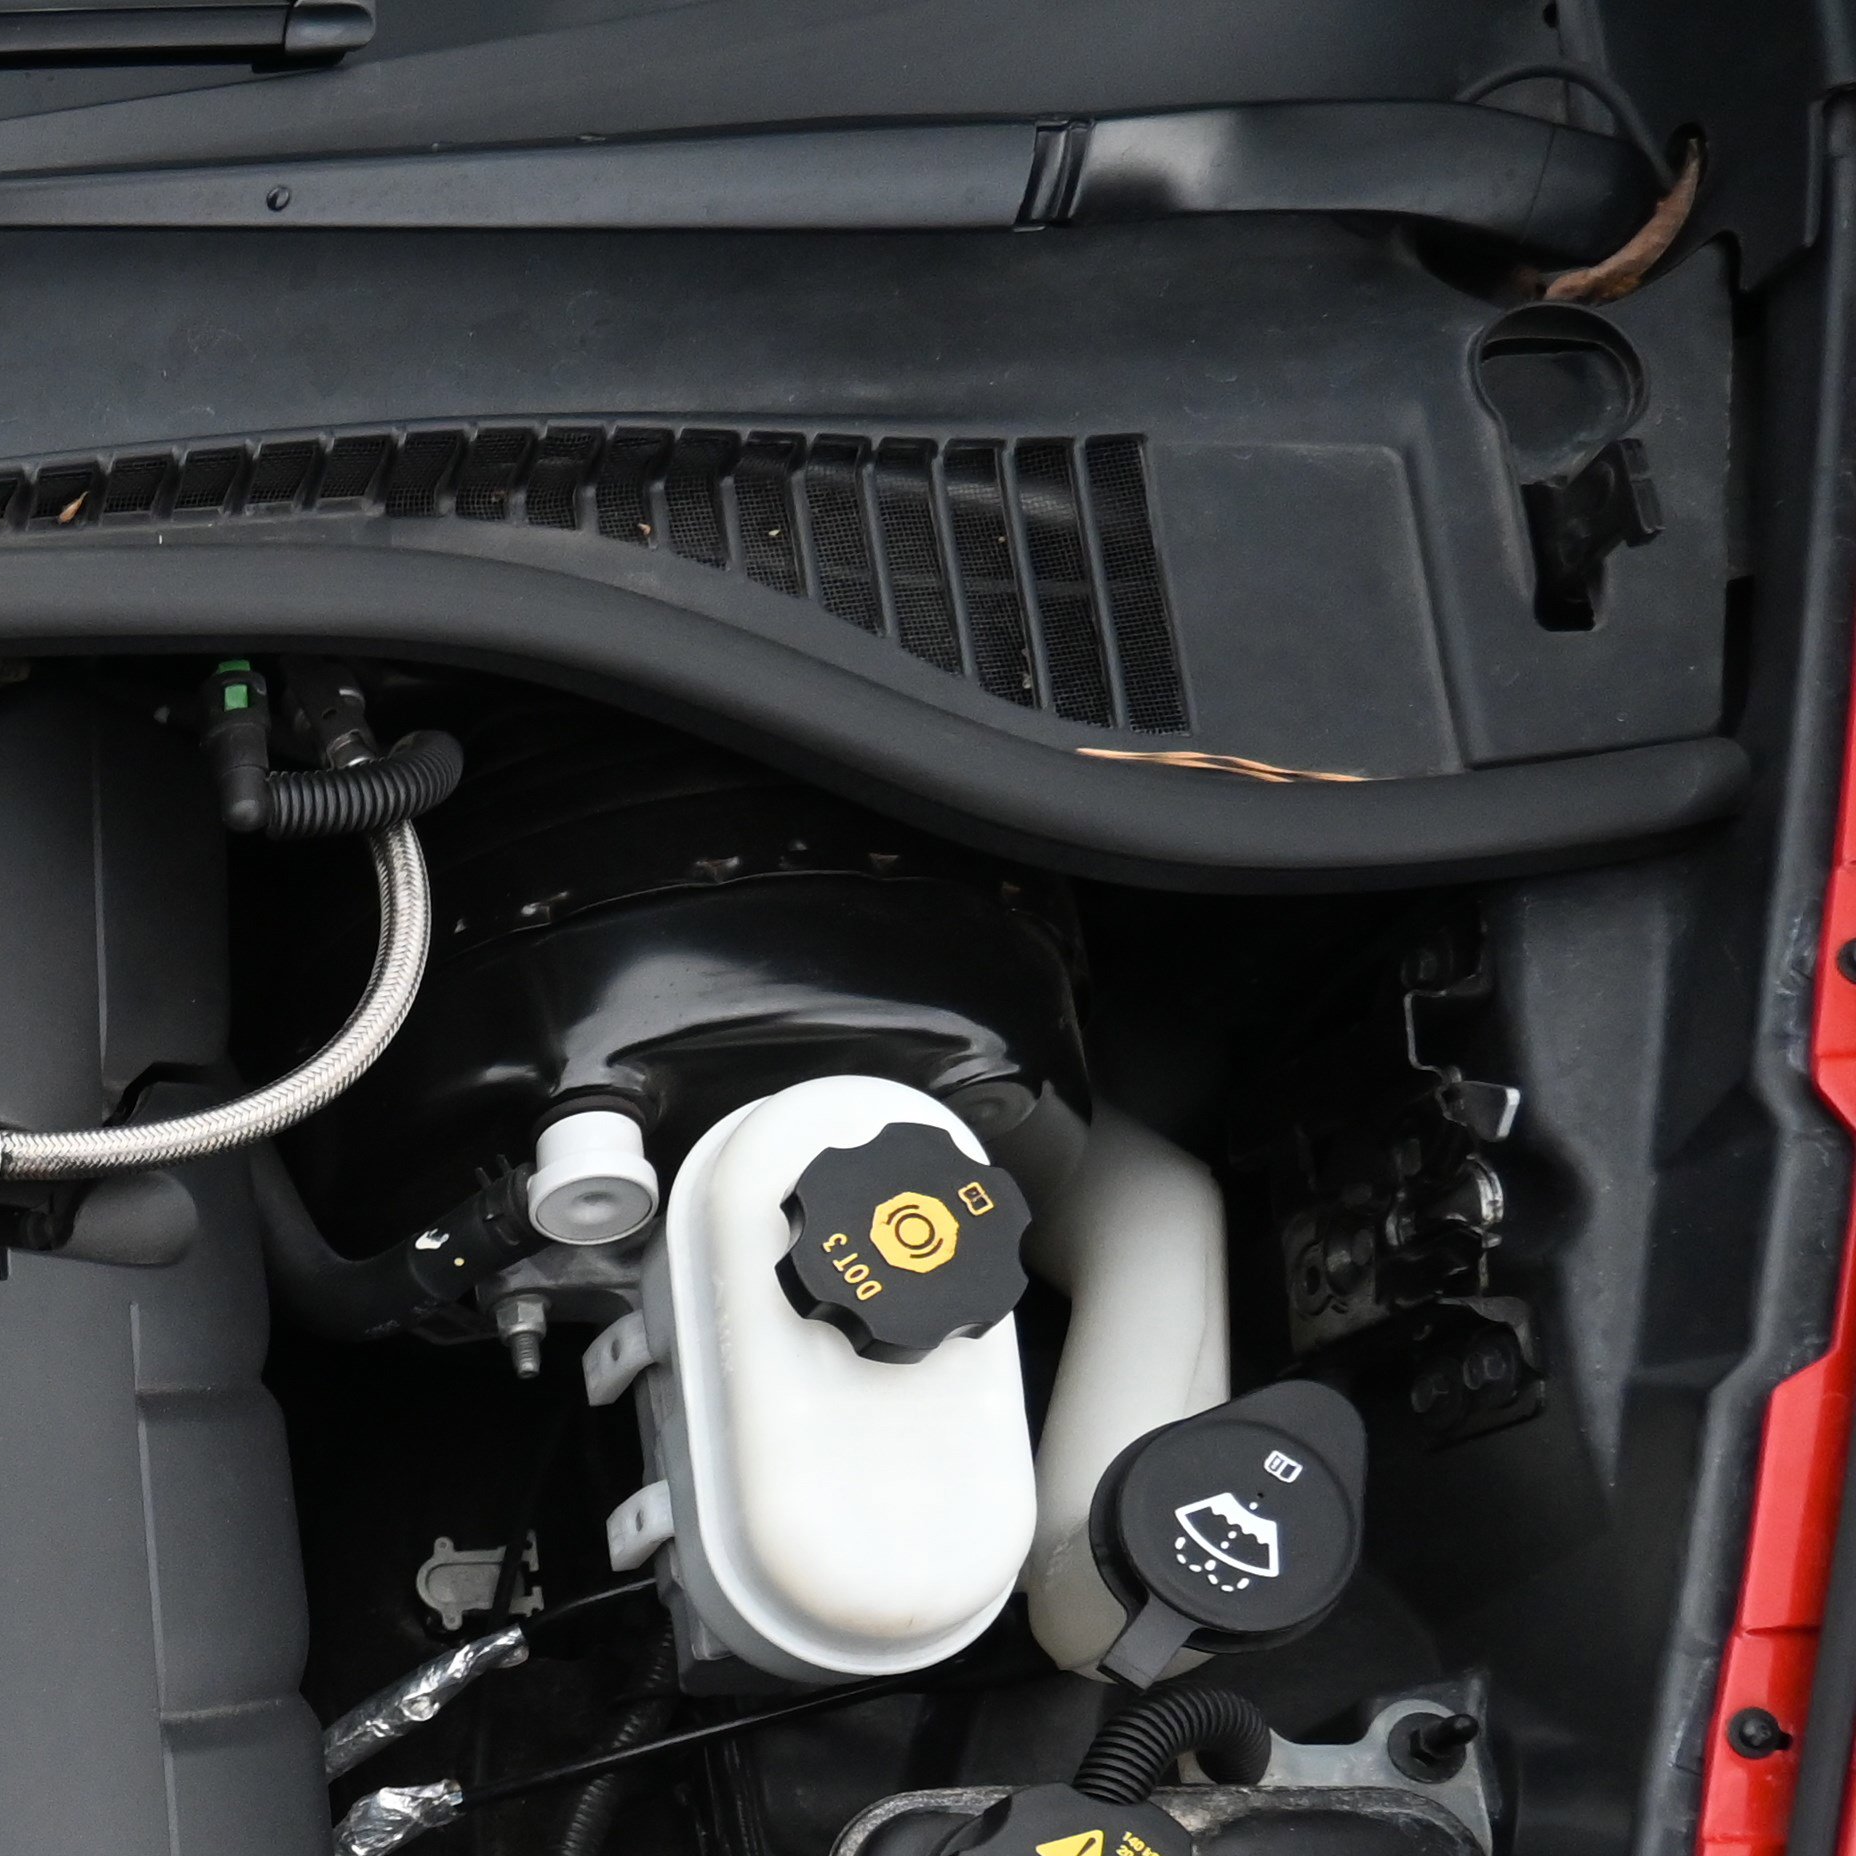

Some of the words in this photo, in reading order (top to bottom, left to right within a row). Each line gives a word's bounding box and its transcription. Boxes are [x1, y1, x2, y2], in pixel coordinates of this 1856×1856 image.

[822, 1232, 848, 1254] 3
[831, 1252, 883, 1301] DOT
[1122, 1831, 1145, 1852] 140
